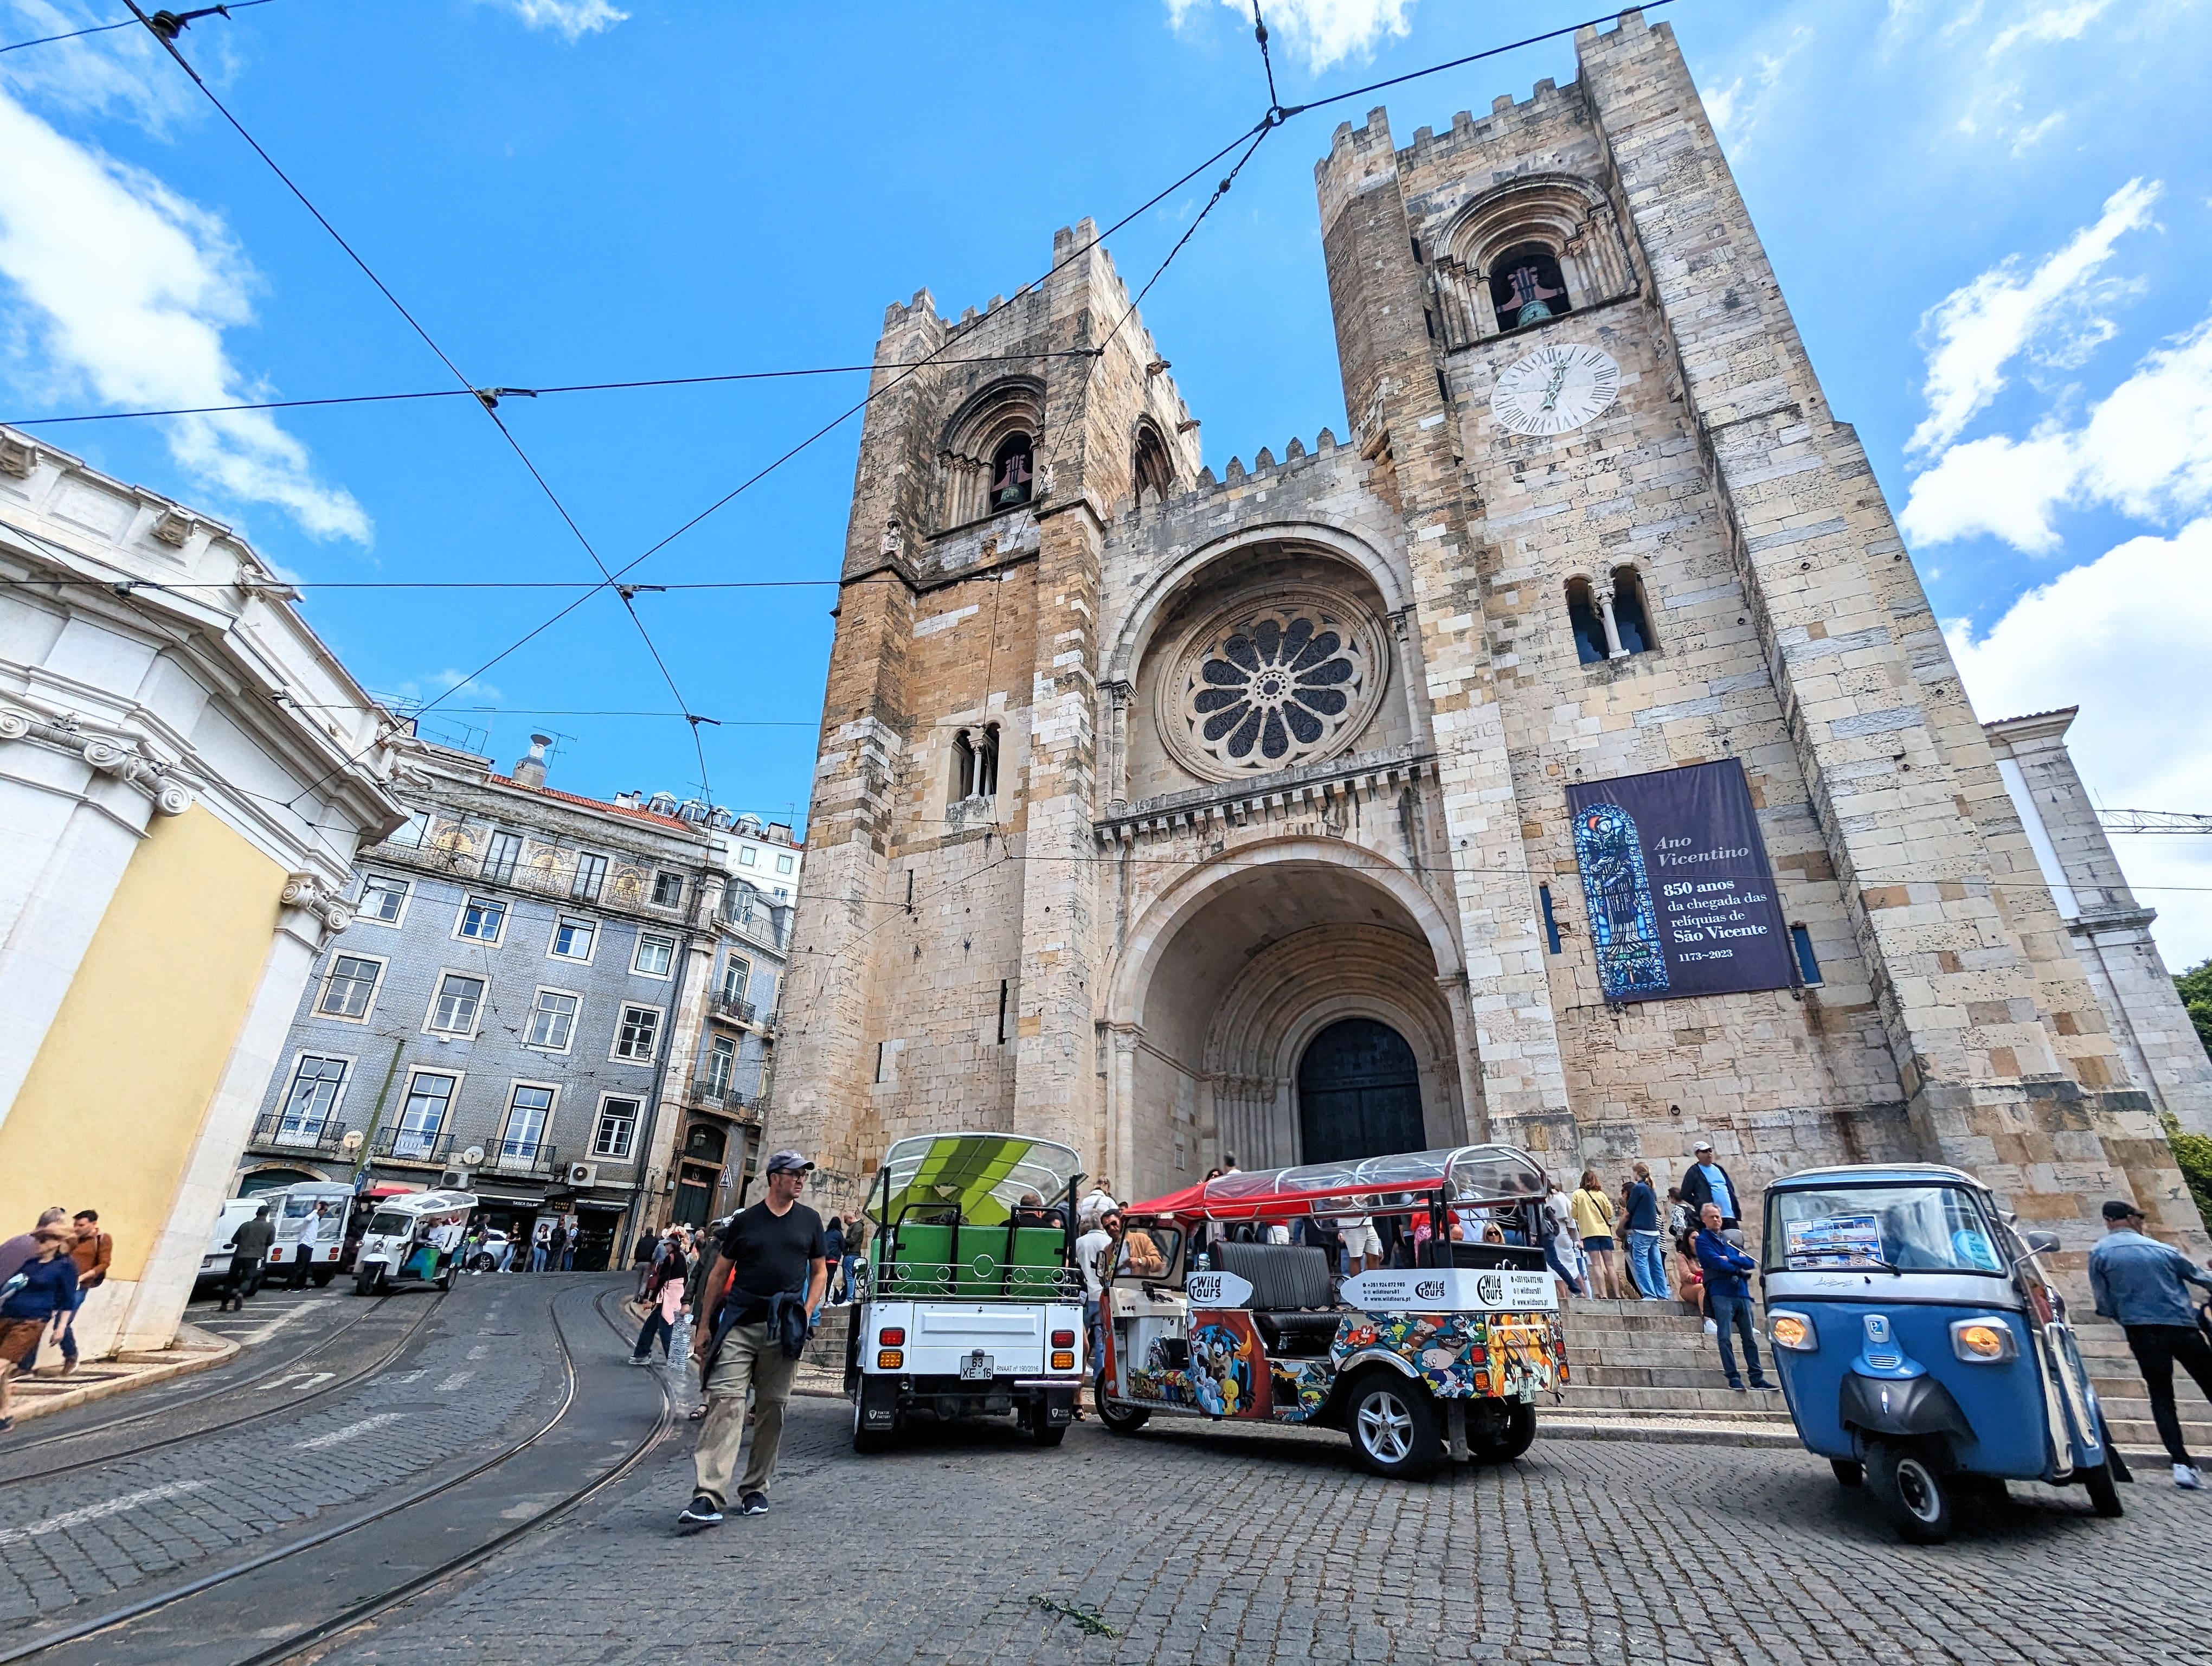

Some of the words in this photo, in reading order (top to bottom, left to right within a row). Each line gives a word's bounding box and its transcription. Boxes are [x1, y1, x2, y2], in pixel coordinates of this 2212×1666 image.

[1654, 836, 1692, 850] Ano
[1658, 847, 1749, 867] Vicentino
[1663, 881, 1693, 896] 850
[1696, 880, 1734, 893] anos
[1668, 901, 1684, 912] da
[1687, 894, 1741, 910] chegada
[1744, 892, 1767, 904] das
[1670, 913, 1726, 928] relíquias
[1729, 909, 1745, 921] de
[1673, 930, 1703, 943] São
[1705, 925, 1767, 939] Vicente
[1197, 1276, 1221, 1288] Wild
[1424, 1281, 1445, 1290] Wild
[1484, 1275, 1501, 1289] Wild
[1192, 1286, 1221, 1298] Tours
[1420, 1287, 1445, 1297] Tours
[1481, 1286, 1503, 1300] Tours
[1517, 1298, 1548, 1307] www.wildtours.pt
[972, 1358, 983, 1368] 63
